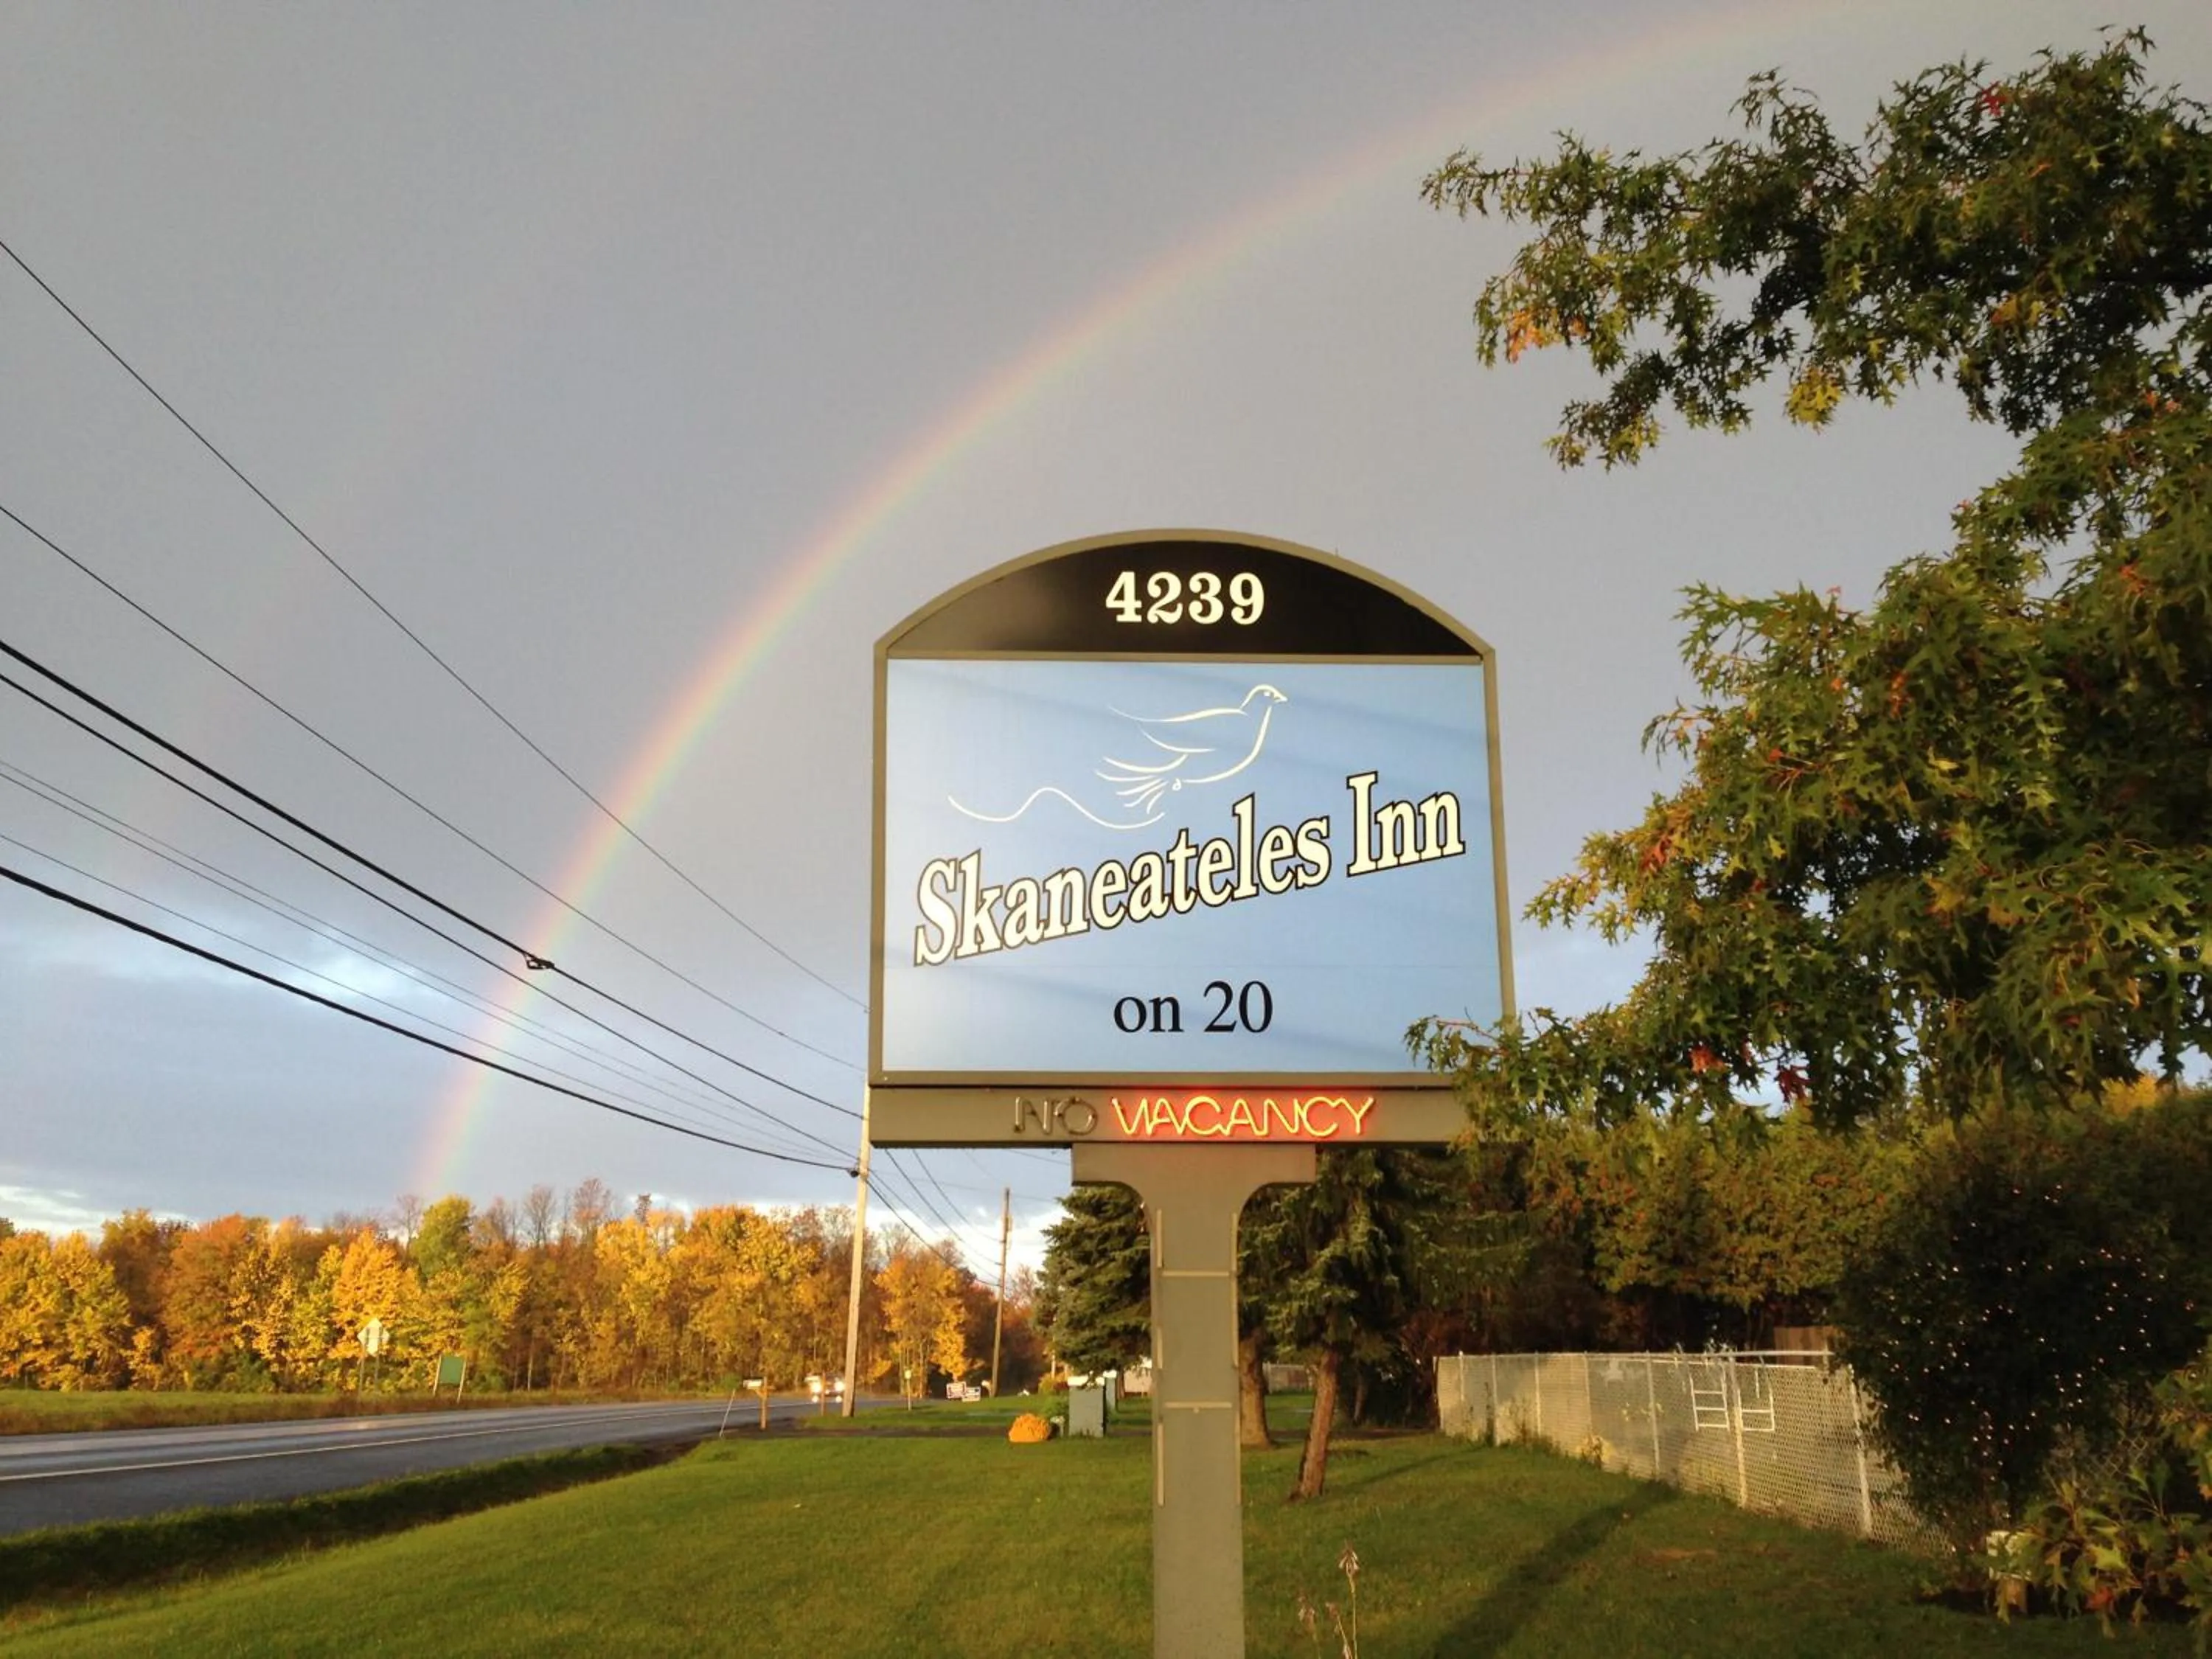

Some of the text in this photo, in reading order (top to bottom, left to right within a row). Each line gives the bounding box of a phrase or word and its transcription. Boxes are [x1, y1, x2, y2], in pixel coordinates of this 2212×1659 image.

[1105, 571, 1266, 626] 4239
[914, 771, 1466, 967] Skaneateles Inn
[1113, 980, 1274, 1034] on 20
[1014, 1096, 1375, 1139] NO VACANCY
